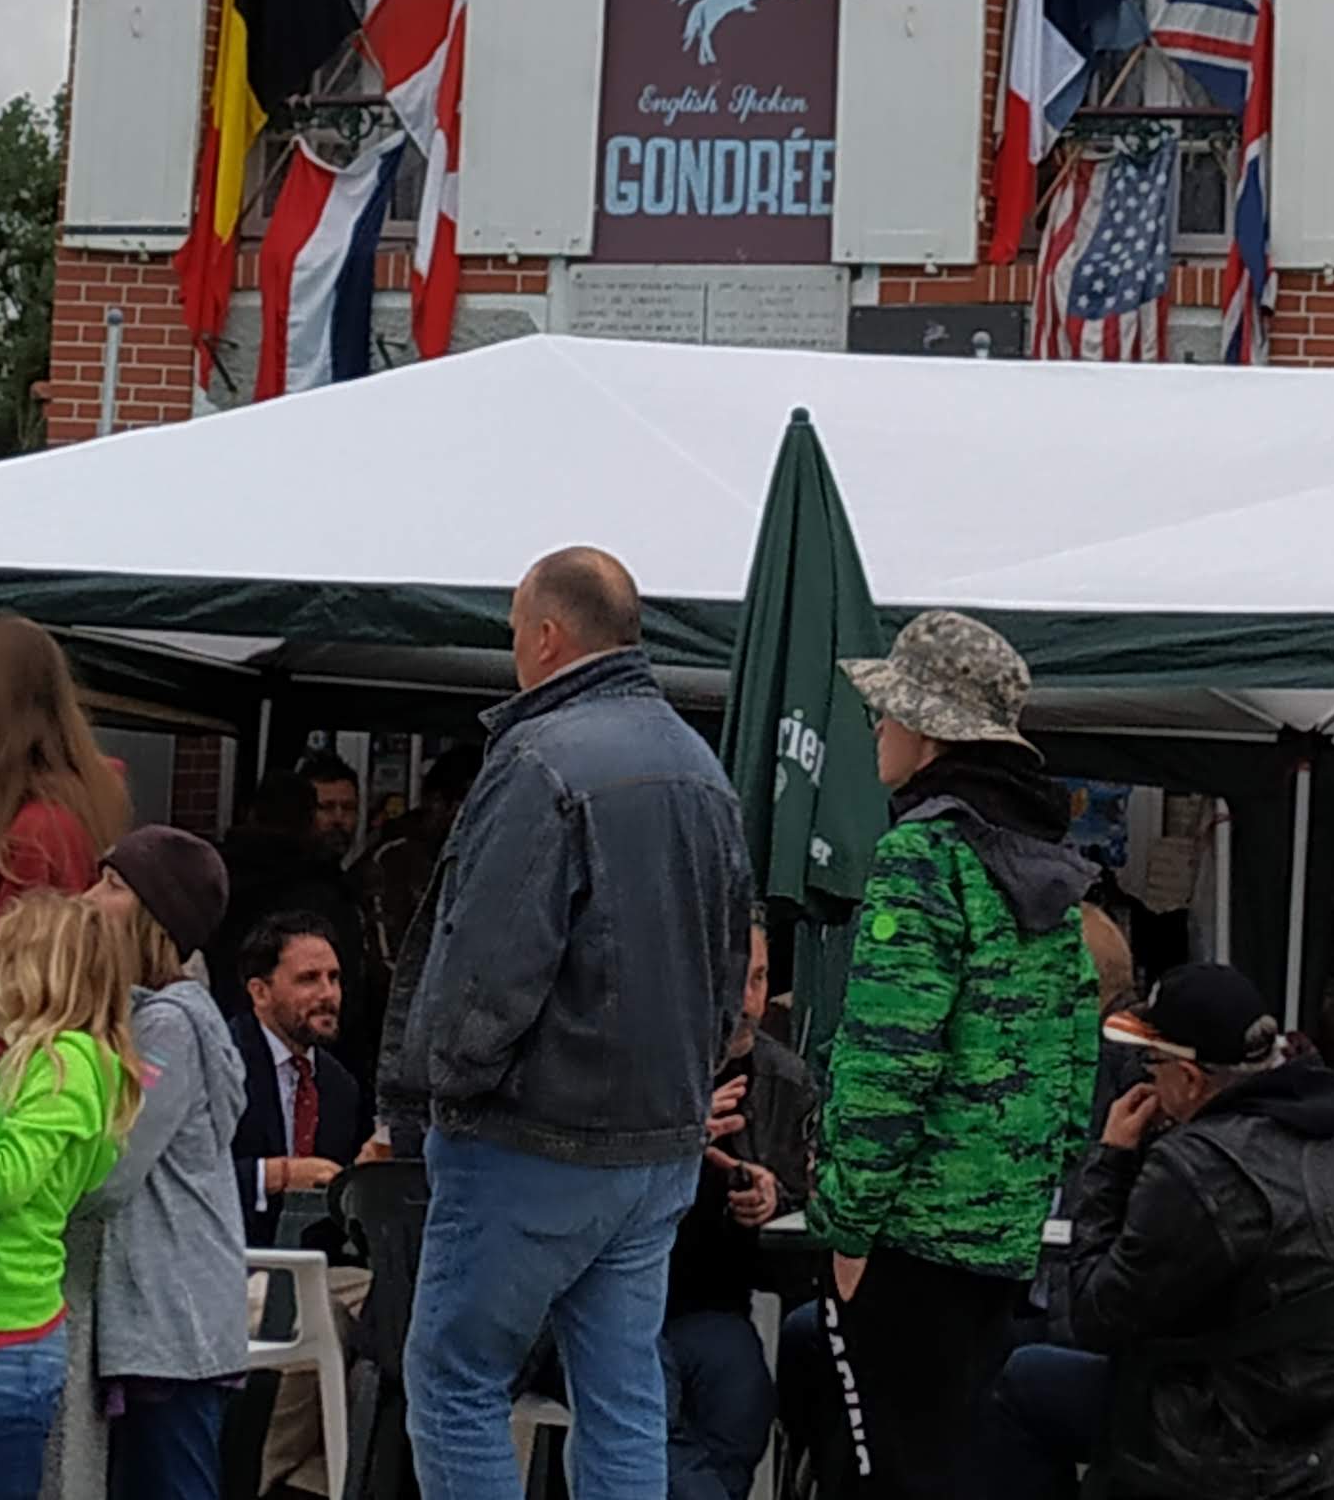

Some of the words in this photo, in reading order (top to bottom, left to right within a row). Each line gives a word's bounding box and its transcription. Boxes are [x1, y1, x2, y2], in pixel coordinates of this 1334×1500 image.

[637, 83, 718, 127] English
[727, 83, 809, 124] Spoken
[603, 126, 836, 216] GONDRÉE
